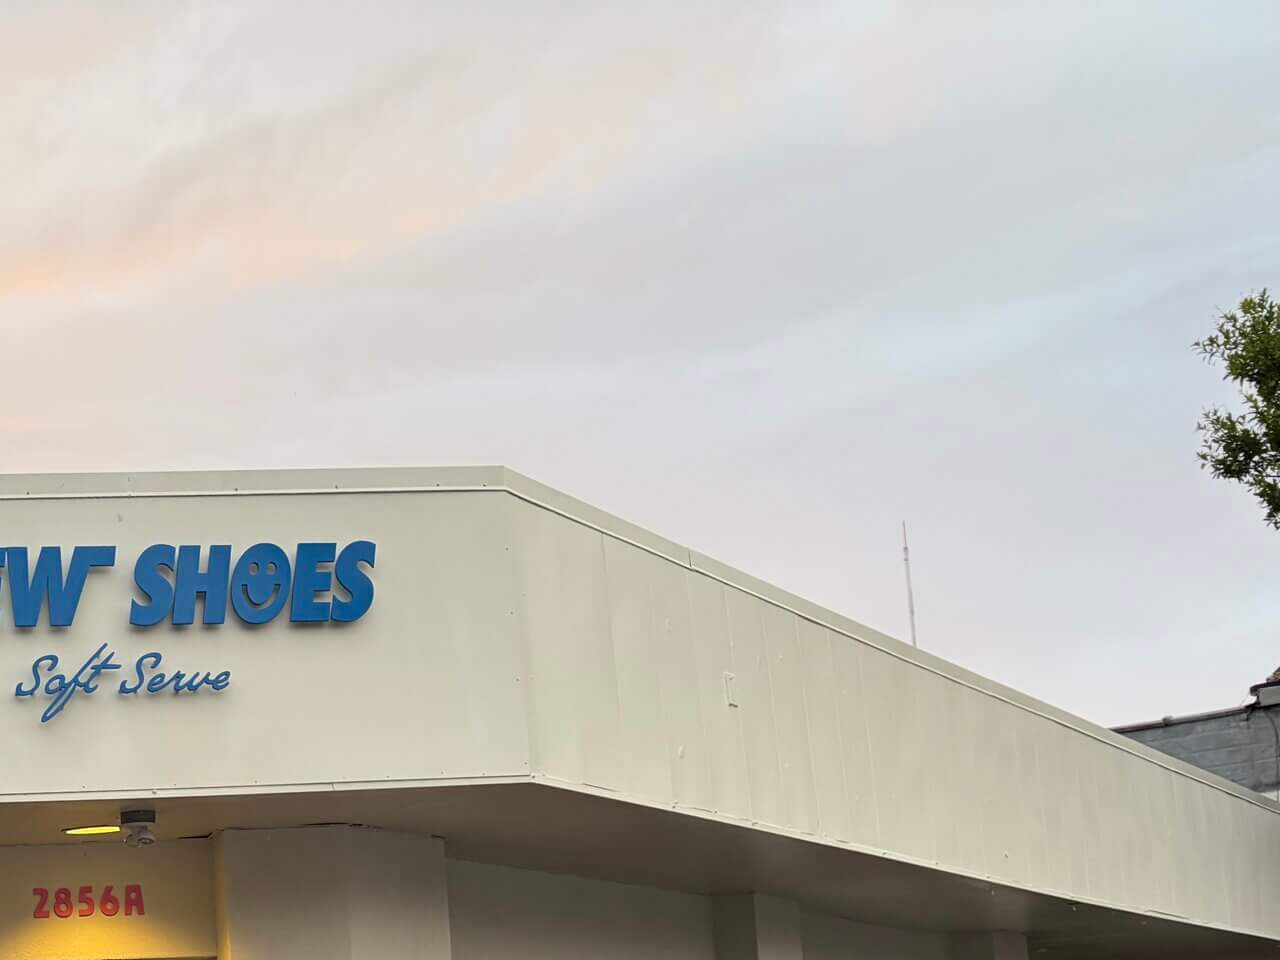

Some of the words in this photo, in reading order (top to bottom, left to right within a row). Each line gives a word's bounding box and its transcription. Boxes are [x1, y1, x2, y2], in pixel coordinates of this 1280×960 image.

[129, 540, 377, 626] SHOES
[15, 642, 121, 723] Soft
[120, 652, 231, 695] Serve
[32, 884, 145, 919] 2856A
